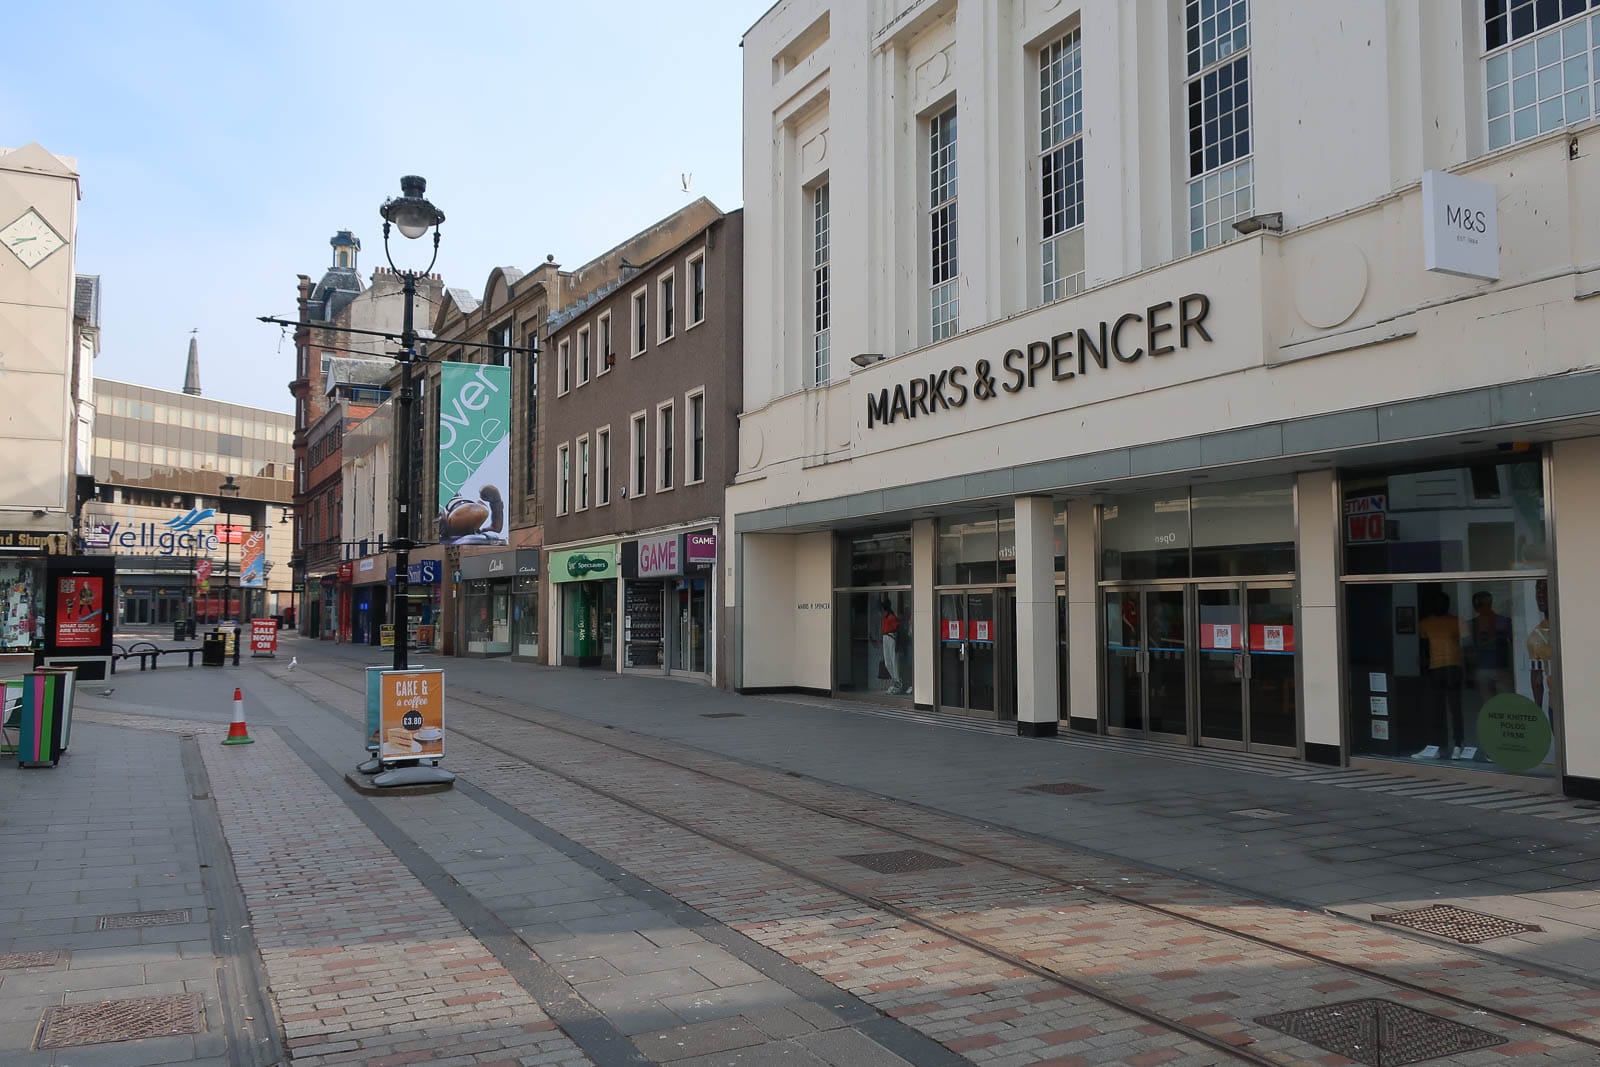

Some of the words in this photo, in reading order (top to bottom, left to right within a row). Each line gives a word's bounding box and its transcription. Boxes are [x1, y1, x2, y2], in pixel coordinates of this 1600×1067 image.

[1447, 204, 1486, 233] M&S
[866, 366, 968, 429] MARKS
[973, 358, 996, 400] &
[1002, 293, 1213, 393] SPENCER
[19, 534, 47, 550] Shop
[106, 520, 219, 555] ellgate
[640, 540, 676, 572] GAME
[423, 565, 434, 582] S
[395, 680, 418, 696] CAKE
[403, 696, 428, 708] coffee
[403, 717, 422, 725] £3.80
